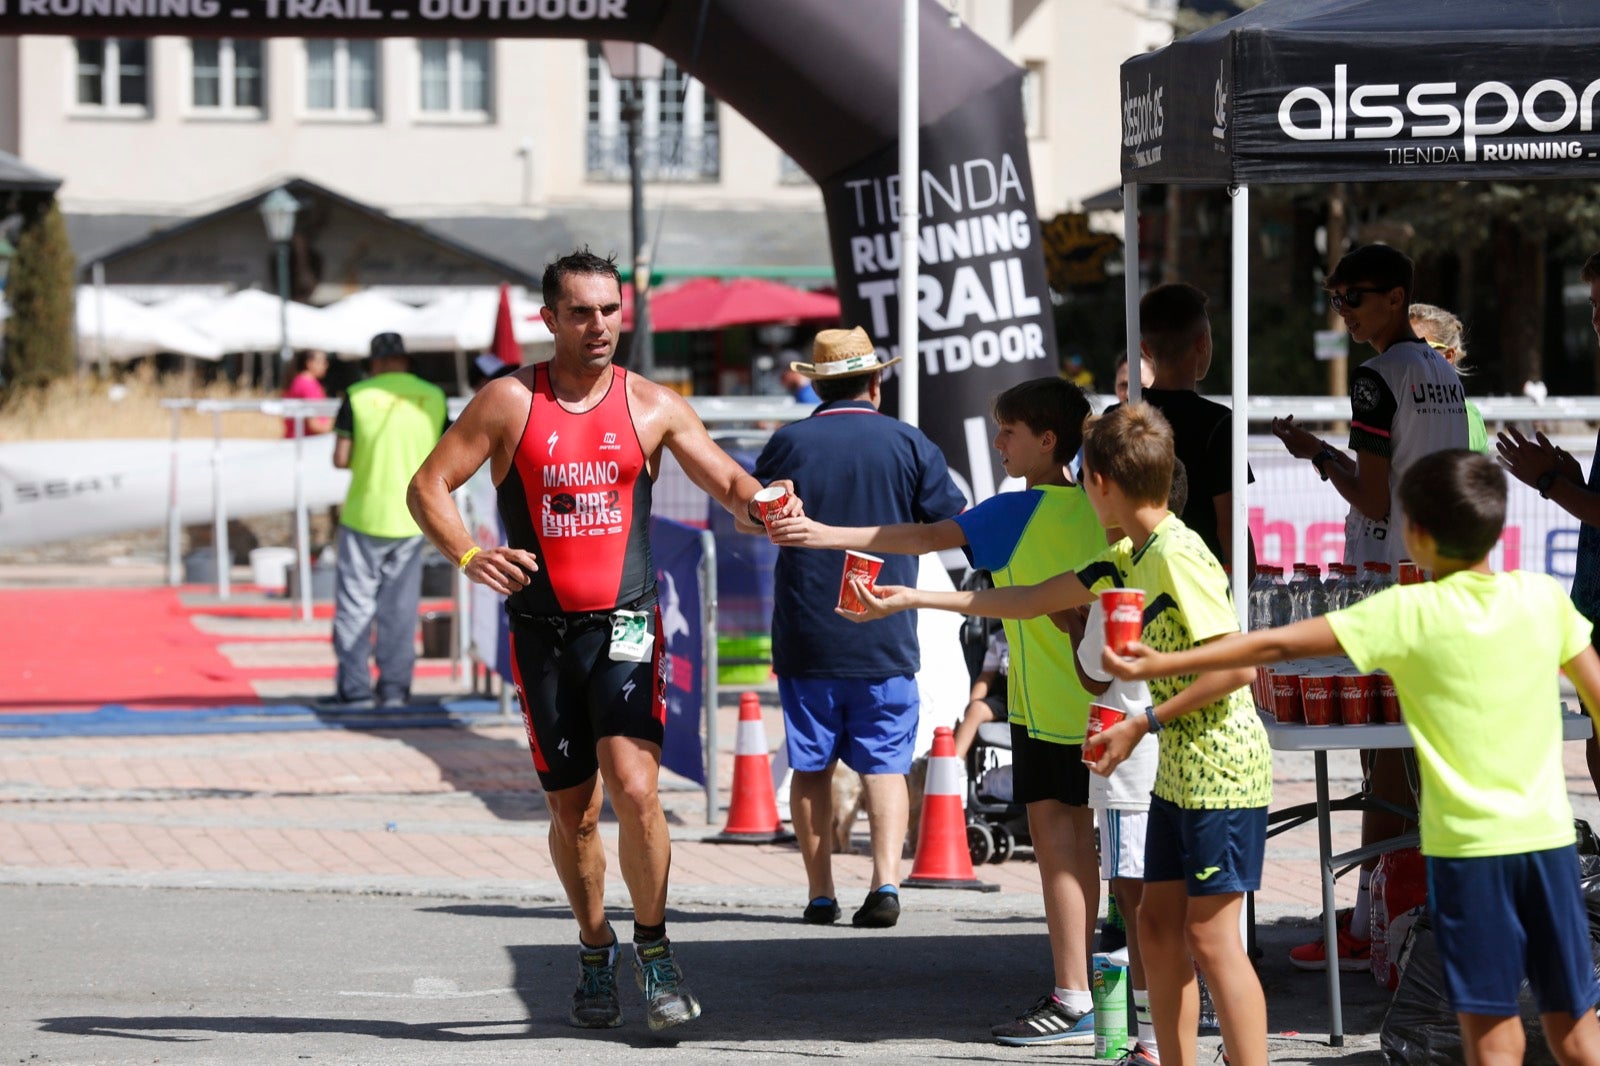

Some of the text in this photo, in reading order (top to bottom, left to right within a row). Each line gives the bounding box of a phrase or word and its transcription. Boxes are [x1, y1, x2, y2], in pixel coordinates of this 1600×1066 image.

[20, 0, 220, 18] RUNNING
[265, 0, 382, 19] TRAIL
[419, 0, 627, 20] OUTDOOR
[1385, 146, 1460, 165] TIENDA
[1484, 141, 1583, 162] RUNNING
[845, 153, 1026, 228] TIENDA
[850, 209, 1032, 275] RUNNING
[857, 257, 1042, 339] TRAIL
[543, 461, 619, 488] MARIANO
[542, 510, 622, 529] RUEDAS
[543, 526, 622, 537] Bikes
